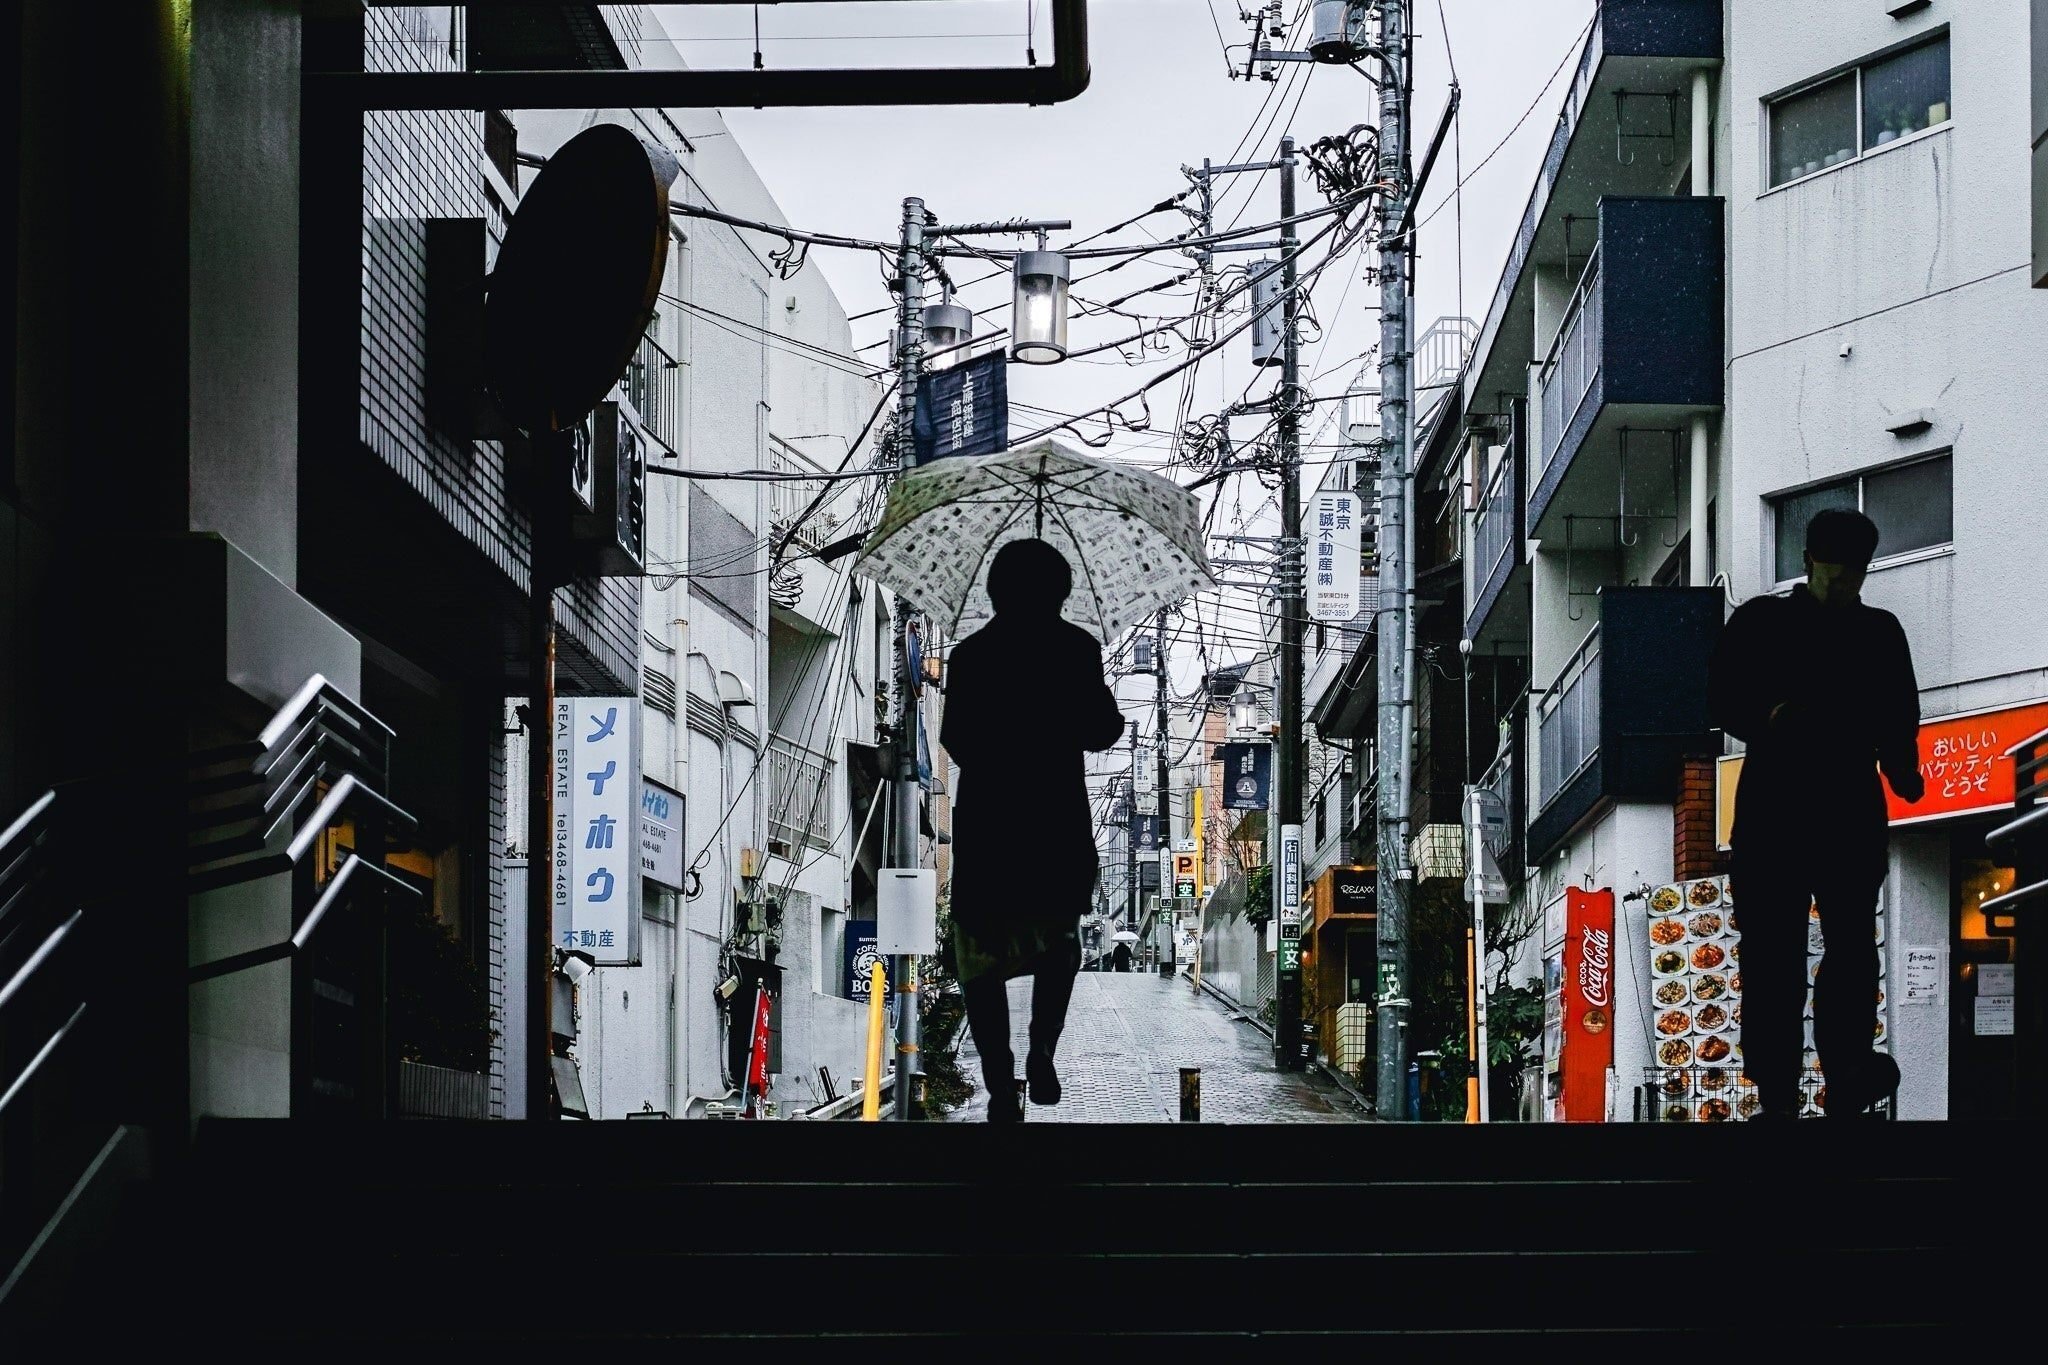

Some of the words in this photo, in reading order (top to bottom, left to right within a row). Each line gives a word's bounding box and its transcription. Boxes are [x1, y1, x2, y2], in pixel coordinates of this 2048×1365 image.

[963, 371, 974, 438] 上原銀座
[951, 400, 962, 450] 商店街
[1336, 498, 1351, 530] 東京
[557, 704, 569, 739] REAL
[1933, 731, 1997, 757] おいしい
[557, 749, 568, 798] ESTATE
[1942, 772, 1990, 798] どうぞ
[586, 707, 617, 903] メイホウ
[650, 825, 667, 841] ESTATE
[556, 813, 568, 907] tel3468-4681
[1179, 857, 1193, 874] P
[1286, 841, 1298, 906] 石川歯科医院
[1178, 883, 1193, 897] 空
[1340, 884, 1375, 894] RELAXX
[563, 930, 615, 948] 不動産
[857, 945, 878, 954] COFF
[1284, 948, 1299, 965] 文
[852, 980, 889, 992] BOS
